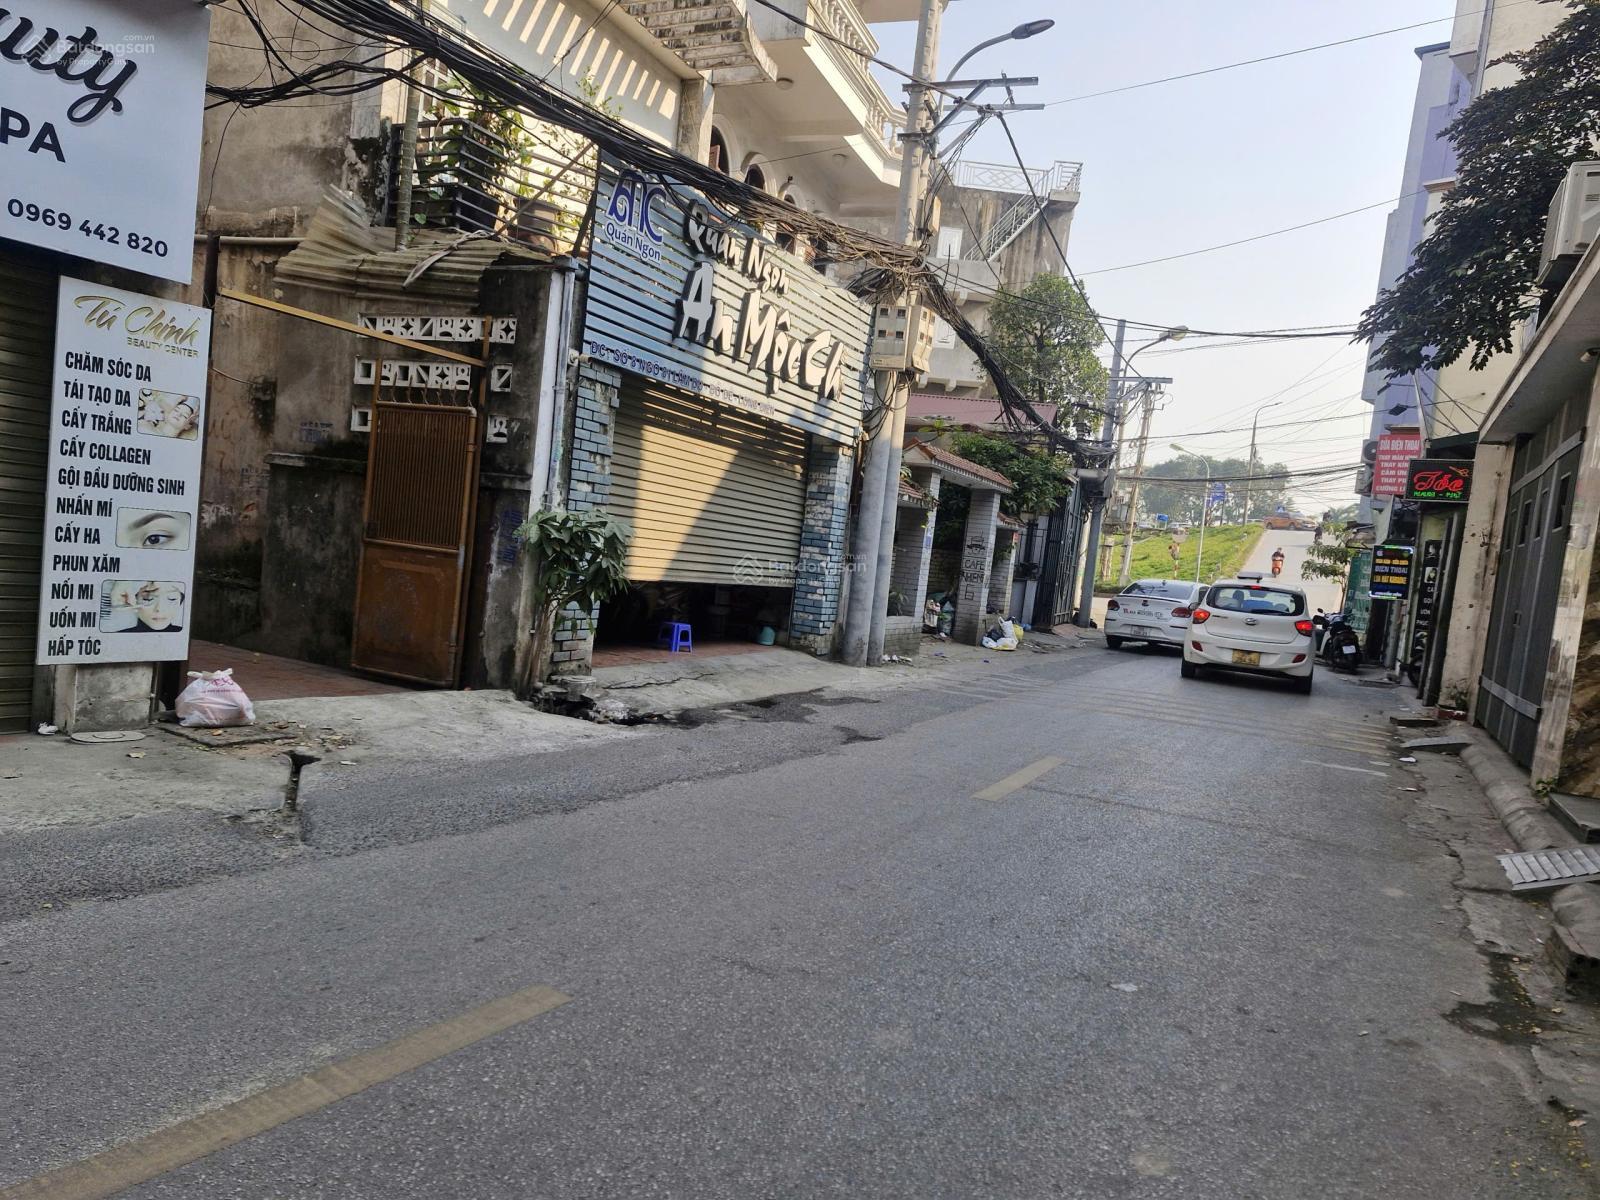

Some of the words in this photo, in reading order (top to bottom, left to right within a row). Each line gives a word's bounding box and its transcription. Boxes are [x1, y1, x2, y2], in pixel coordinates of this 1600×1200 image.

[0, 8, 137, 122] uty
[0, 107, 66, 163] PA
[7, 198, 72, 231] 0969
[79, 219, 120, 245] 442
[127, 232, 169, 258] 820
[606, 223, 633, 245] Quán
[635, 237, 661, 260] Ngon
[74, 295, 126, 330] Tú
[127, 337, 163, 349] BEAUTY
[165, 344, 199, 358] CENTER
[65, 351, 103, 374] CHĂM
[107, 358, 132, 379] SÓC
[136, 364, 152, 382] DA
[63, 379, 84, 400] TÁI
[87, 384, 111, 406] TẠO
[115, 389, 131, 407] DA
[61, 406, 87, 429] CẤY
[91, 411, 132, 435] TRẮNG
[60, 435, 86, 458] CẤY
[89, 442, 151, 465] COLLAGEN
[58, 466, 80, 489] GỘI
[84, 466, 109, 489] ĐẦU
[113, 472, 154, 493] DƯỠNG
[157, 478, 185, 496] SINH
[56, 493, 92, 516] NHẤN
[96, 498, 113, 517] MÍ
[55, 521, 80, 543] CẤY
[84, 528, 100, 544] HA
[53, 555, 88, 572] PHUN
[92, 554, 120, 573] XĂM
[51, 578, 73, 600] NỐI
[78, 584, 94, 600] MI
[49, 606, 77, 628] UỐN
[80, 612, 96, 628] MI
[48, 634, 74, 656] HẤP
[78, 637, 101, 656] TÓC
